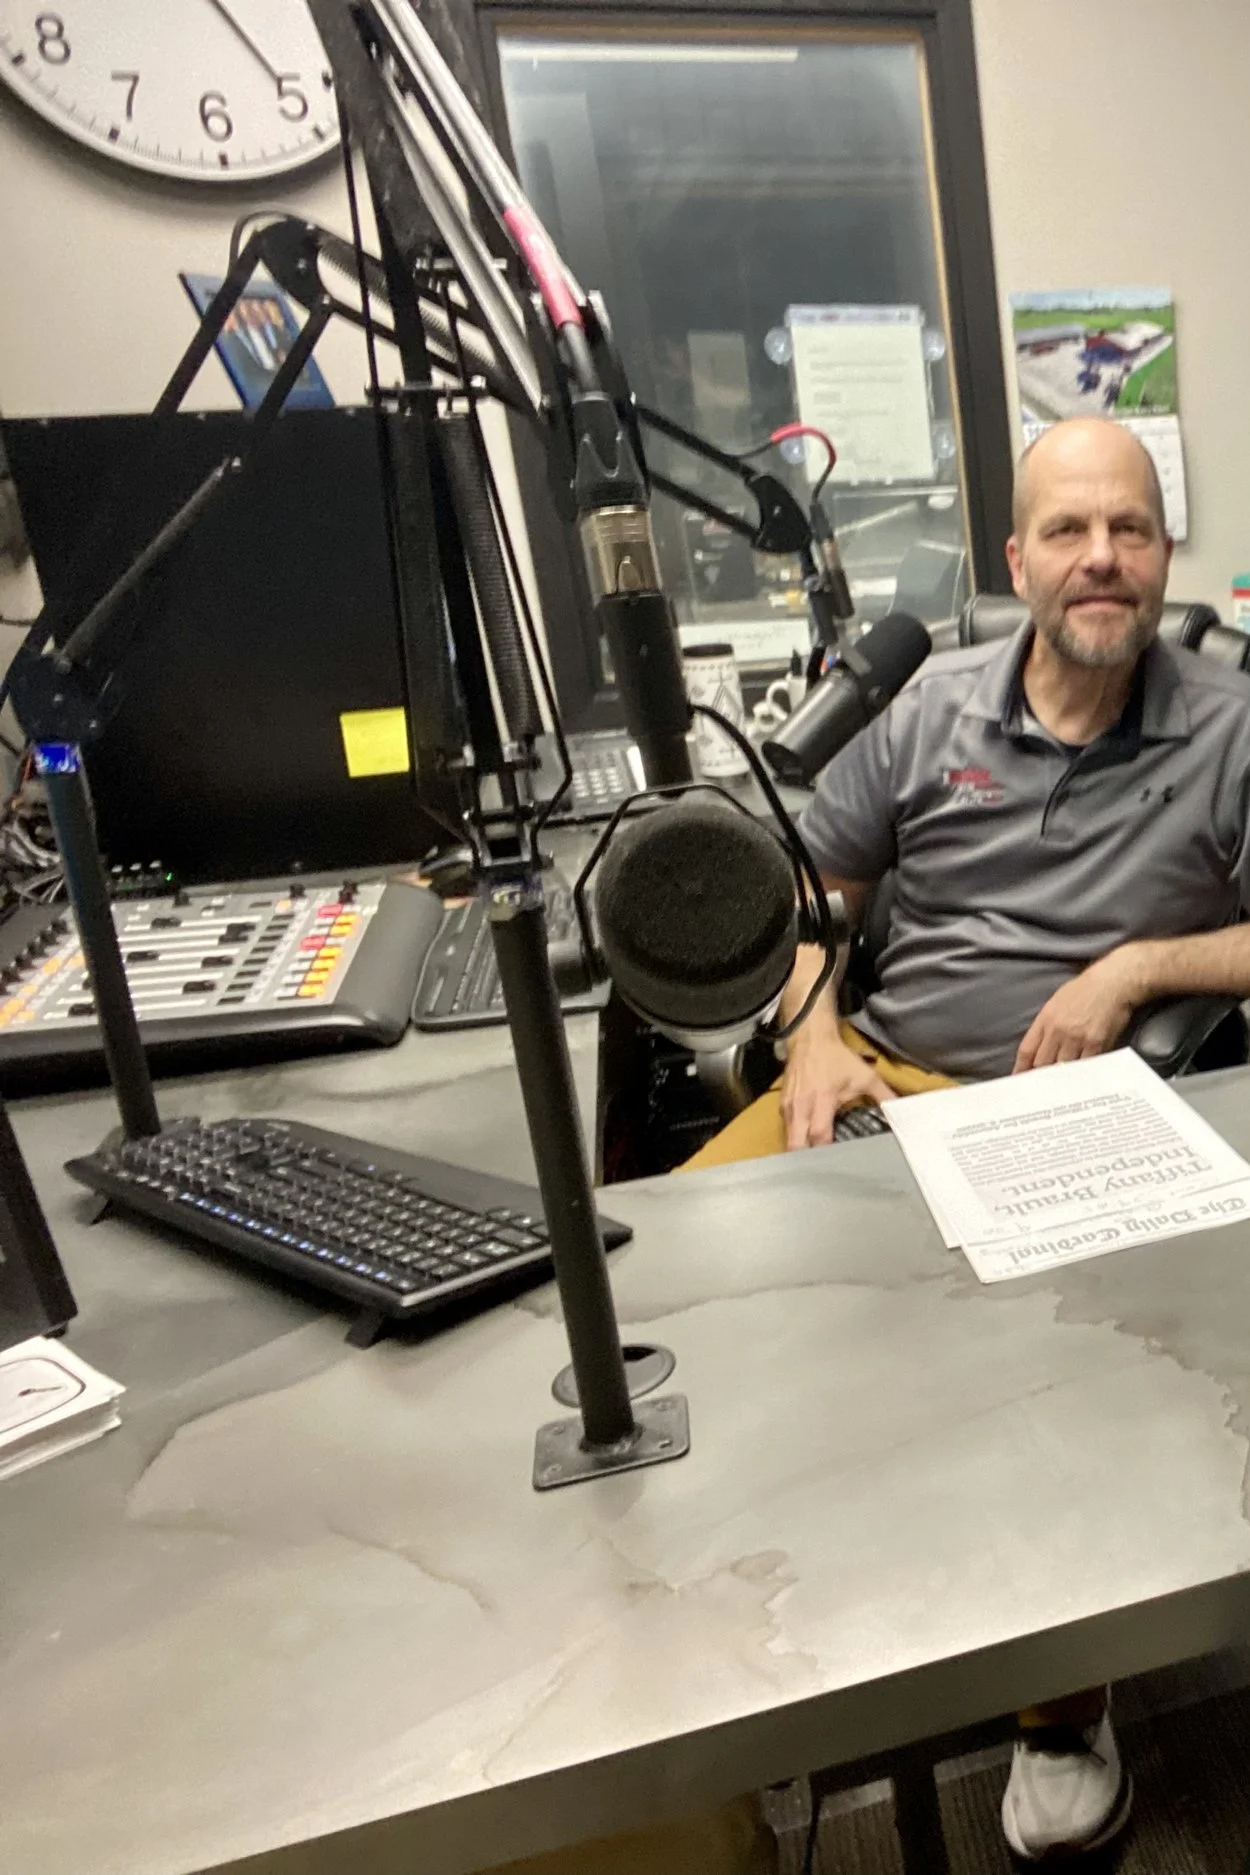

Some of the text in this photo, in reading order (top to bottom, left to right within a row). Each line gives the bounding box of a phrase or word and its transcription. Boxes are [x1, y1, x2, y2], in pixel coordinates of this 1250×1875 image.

[34, 12, 71, 65] 8
[111, 71, 140, 121] 7
[199, 90, 234, 142] 6
[277, 73, 309, 122] 5
[1002, 1144, 1198, 1199] Independent.
[1102, 1159, 1213, 1194] Tiffany
[1008, 1196, 1247, 1265] The Daily Cardinal
